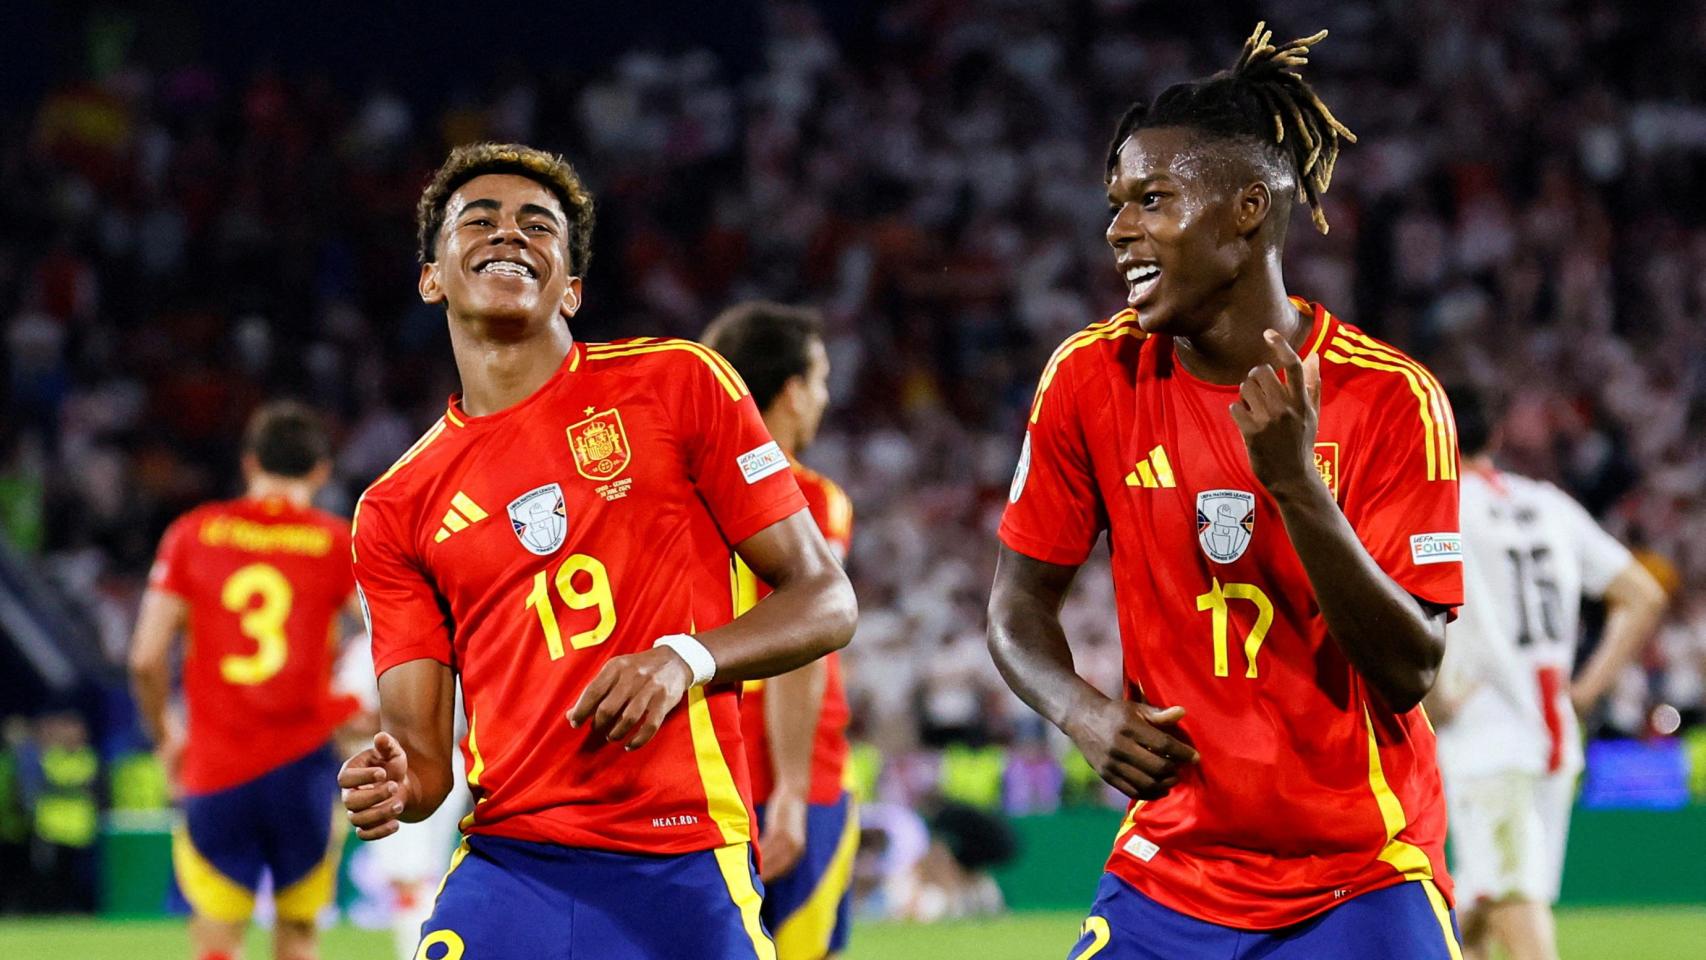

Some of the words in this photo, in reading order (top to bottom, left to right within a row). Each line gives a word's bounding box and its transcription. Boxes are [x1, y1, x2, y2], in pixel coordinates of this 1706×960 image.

[740, 452, 756, 465] UEFA
[1413, 535, 1433, 543] UEFA
[1415, 541, 1461, 554] FOUND
[525, 553, 617, 661] 19
[220, 562, 293, 686] 3
[1196, 576, 1274, 679] 17
[652, 815, 698, 828] HEAT.RDY
